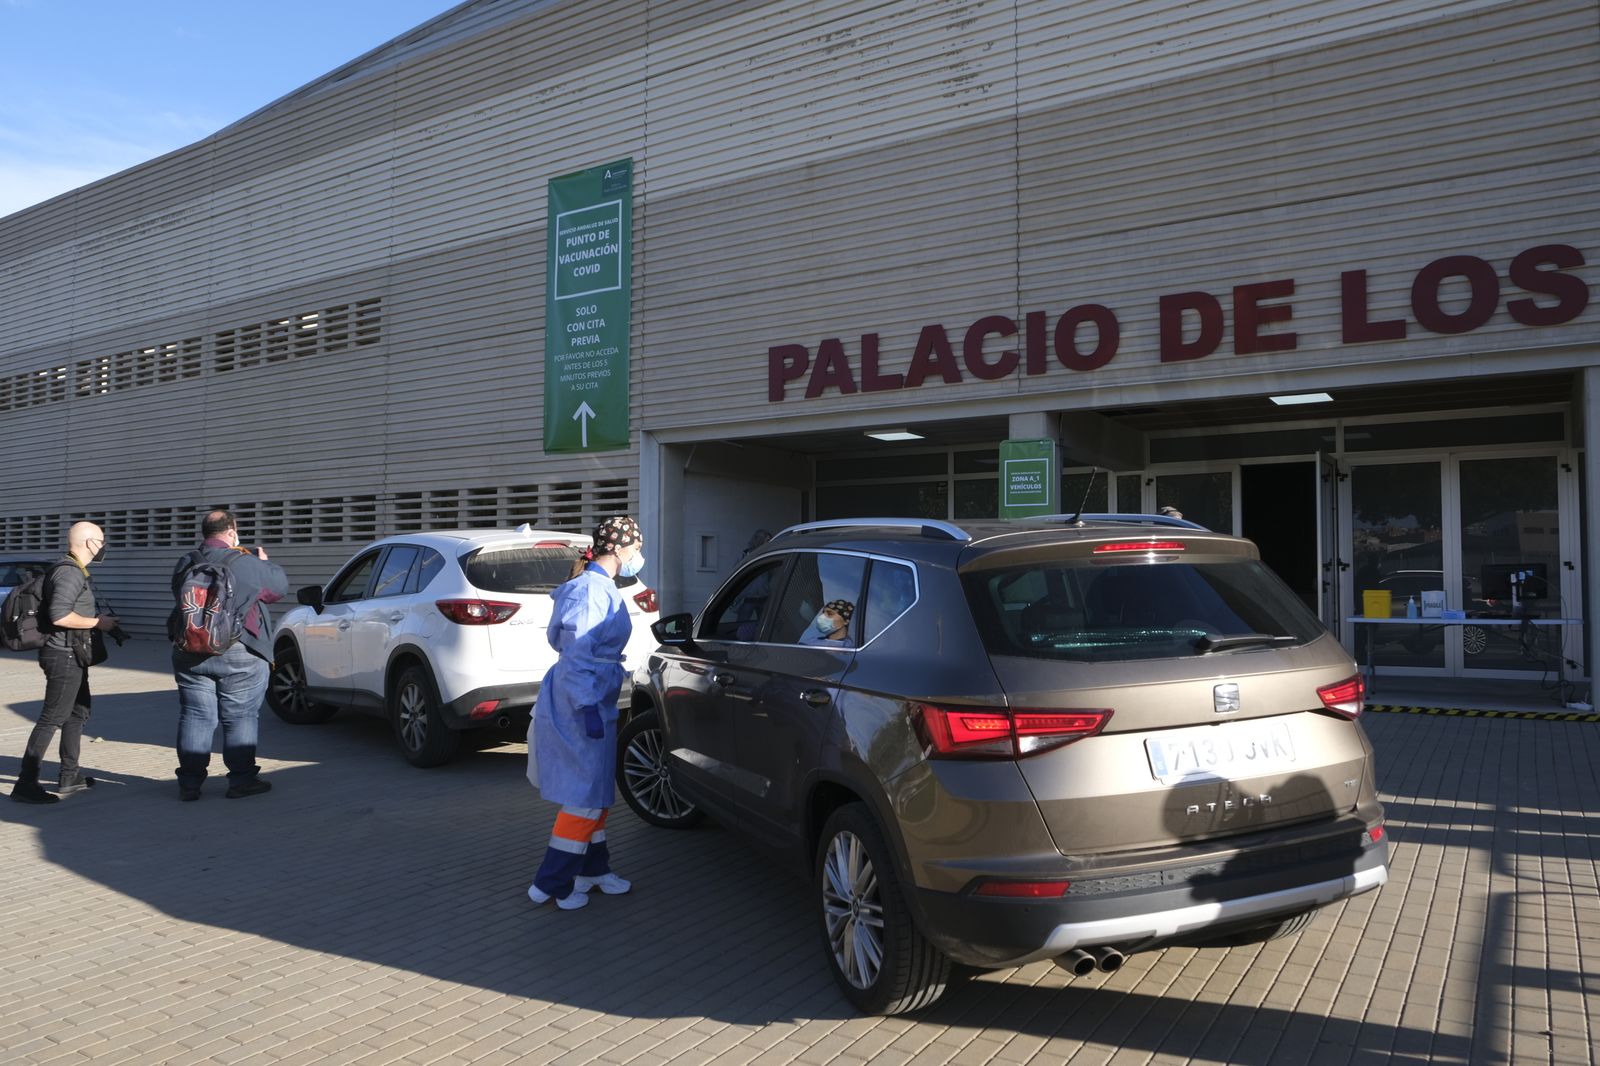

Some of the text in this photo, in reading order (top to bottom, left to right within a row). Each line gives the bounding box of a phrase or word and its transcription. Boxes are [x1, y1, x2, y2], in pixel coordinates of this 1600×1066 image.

[605, 217, 619, 225] SALUD
[566, 229, 610, 248] PUNTO DE
[558, 243, 619, 265] VACUNACIÓN
[573, 263, 600, 277] COVID
[575, 304, 597, 317] SOLO
[566, 318, 606, 333] CON CITA
[768, 244, 1590, 403] PALACIO DE LOS
[571, 334, 601, 347] PREVIA
[554, 346, 619, 363] POR FAVOR NO ACCEDA
[563, 362, 582, 371] ANTES
[582, 361, 591, 369] DE
[591, 359, 603, 368] LOS
[559, 369, 611, 382] MINUTOS PREVIOS
[570, 381, 599, 392] A SU CITA
